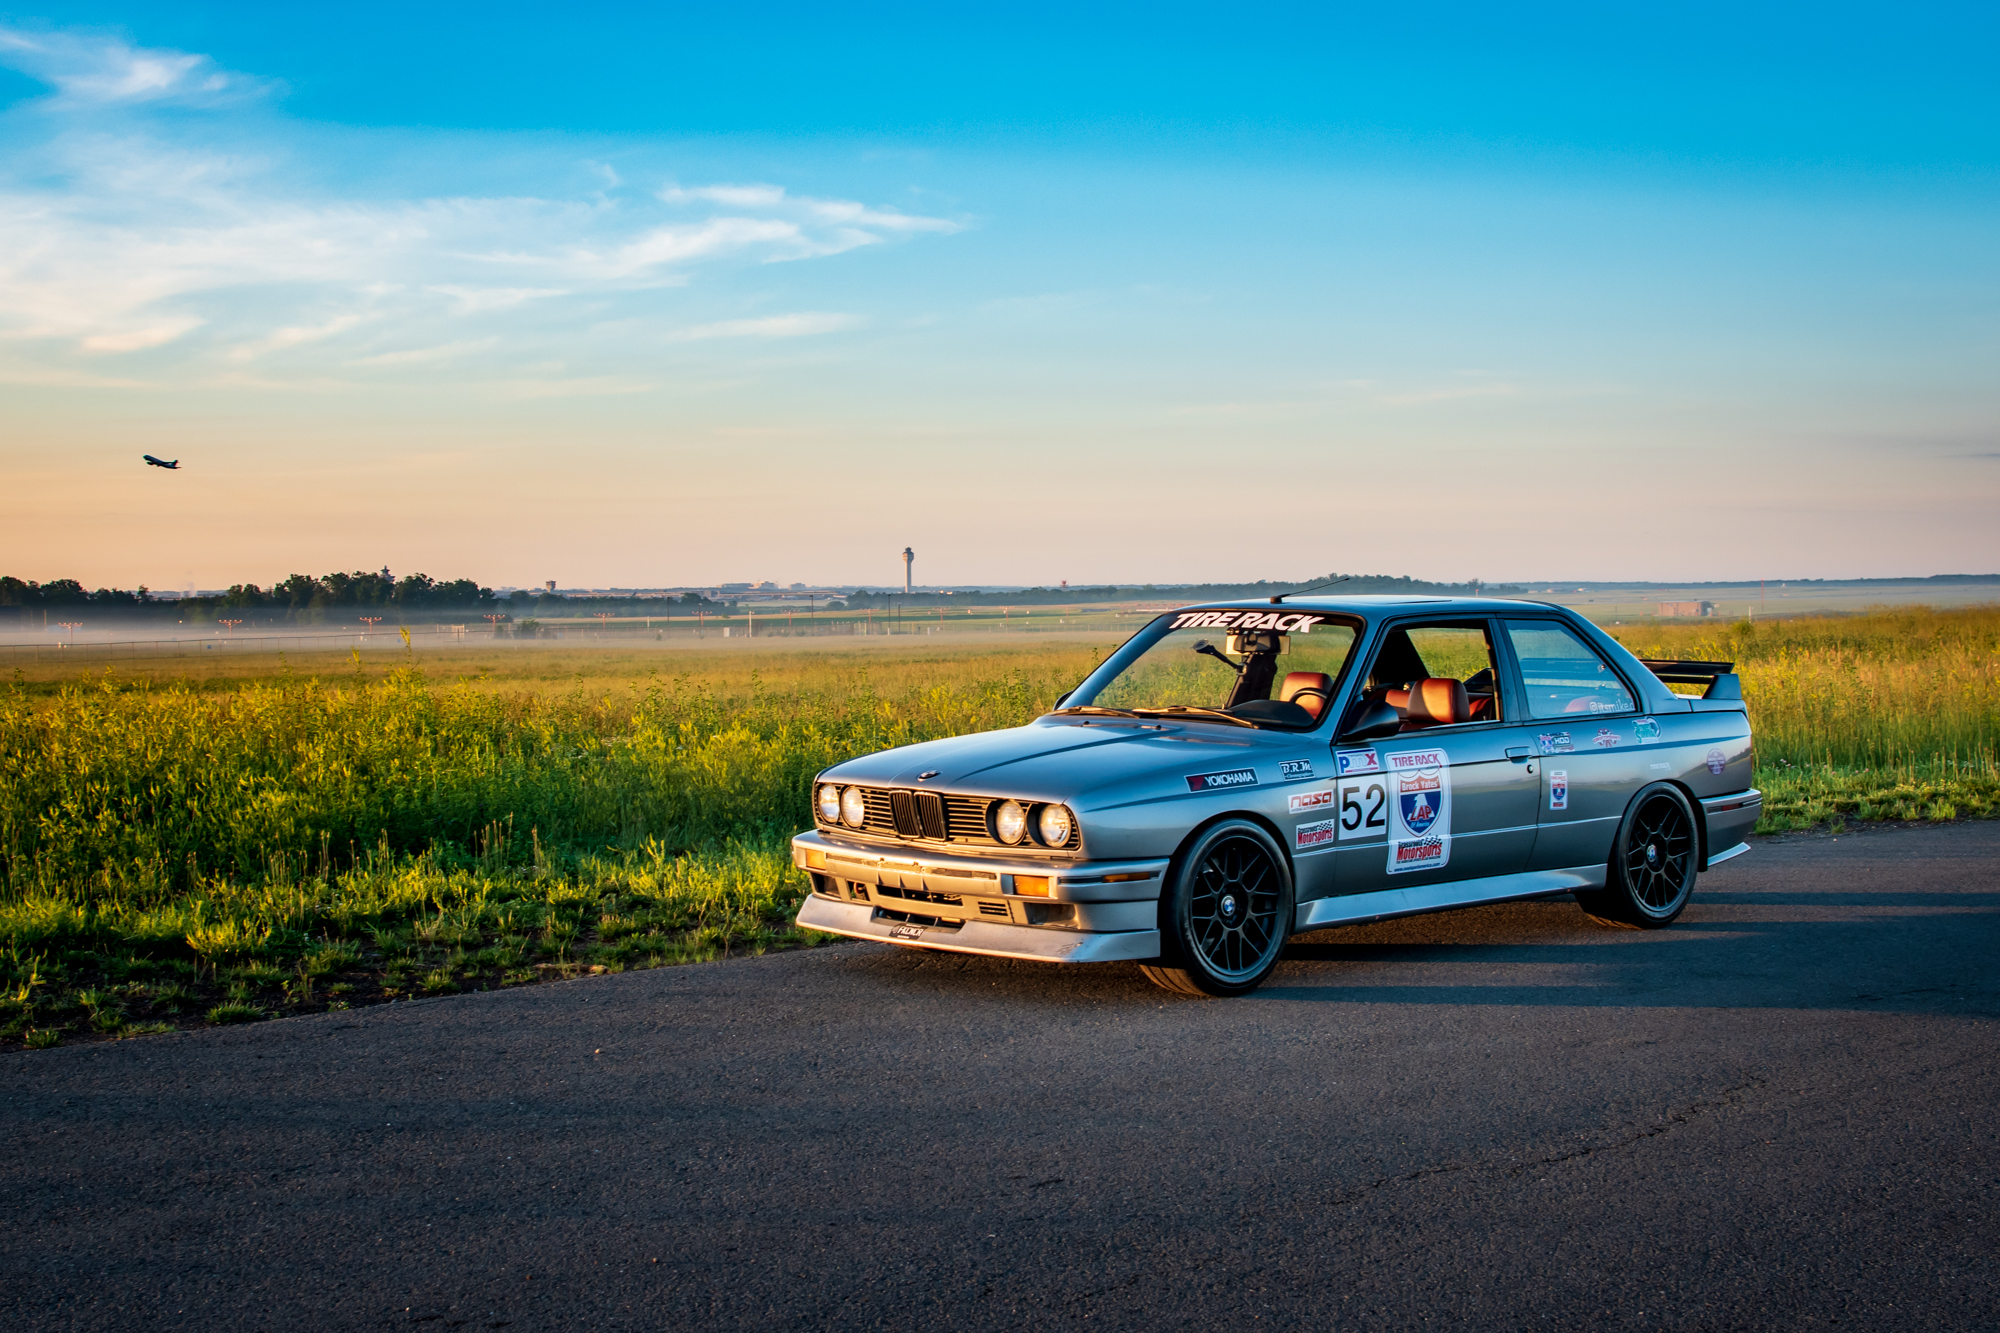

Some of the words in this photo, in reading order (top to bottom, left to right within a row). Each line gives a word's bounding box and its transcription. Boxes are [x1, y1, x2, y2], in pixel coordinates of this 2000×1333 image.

[1169, 612, 1242, 629] TIRE
[1229, 612, 1325, 633] RACK
[1391, 756, 1415, 767] TIRE
[1414, 753, 1442, 768] RACK
[1204, 771, 1255, 787] YOKOHAMA
[1401, 780, 1420, 791] Brock
[1341, 783, 1386, 831] 52
[1409, 804, 1433, 821] LAP
[1297, 828, 1333, 845] Motorsports
[1396, 842, 1442, 861] Motorsports
